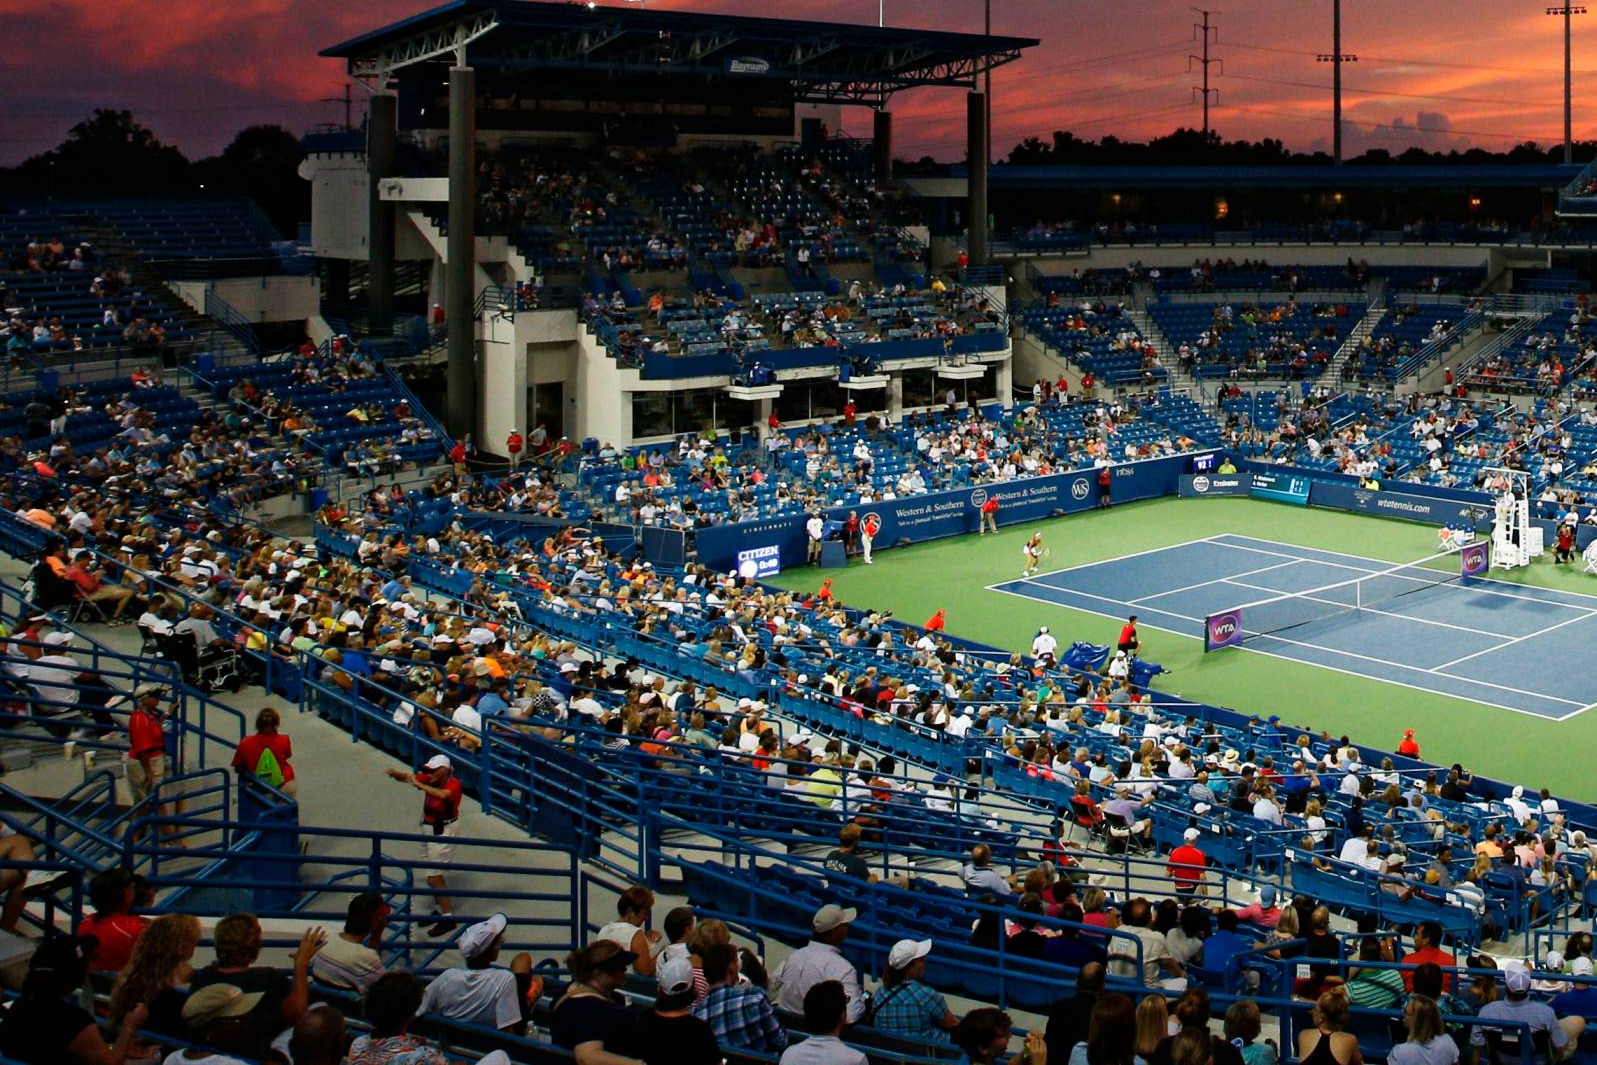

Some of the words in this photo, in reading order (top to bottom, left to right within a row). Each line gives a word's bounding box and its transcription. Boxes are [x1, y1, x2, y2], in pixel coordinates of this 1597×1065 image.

[995, 491, 1021, 501] Western
[1021, 488, 1029, 497] &
[1029, 485, 1057, 496] Southern
[896, 507, 925, 518] Western
[925, 504, 932, 514] &
[934, 501, 964, 512] Southern
[1377, 498, 1431, 514] wtatennis.com
[743, 521, 792, 534] CINCINNATI
[738, 545, 779, 561] CITIZEN
[1467, 555, 1481, 565] WTA
[1214, 623, 1235, 635] WTA
